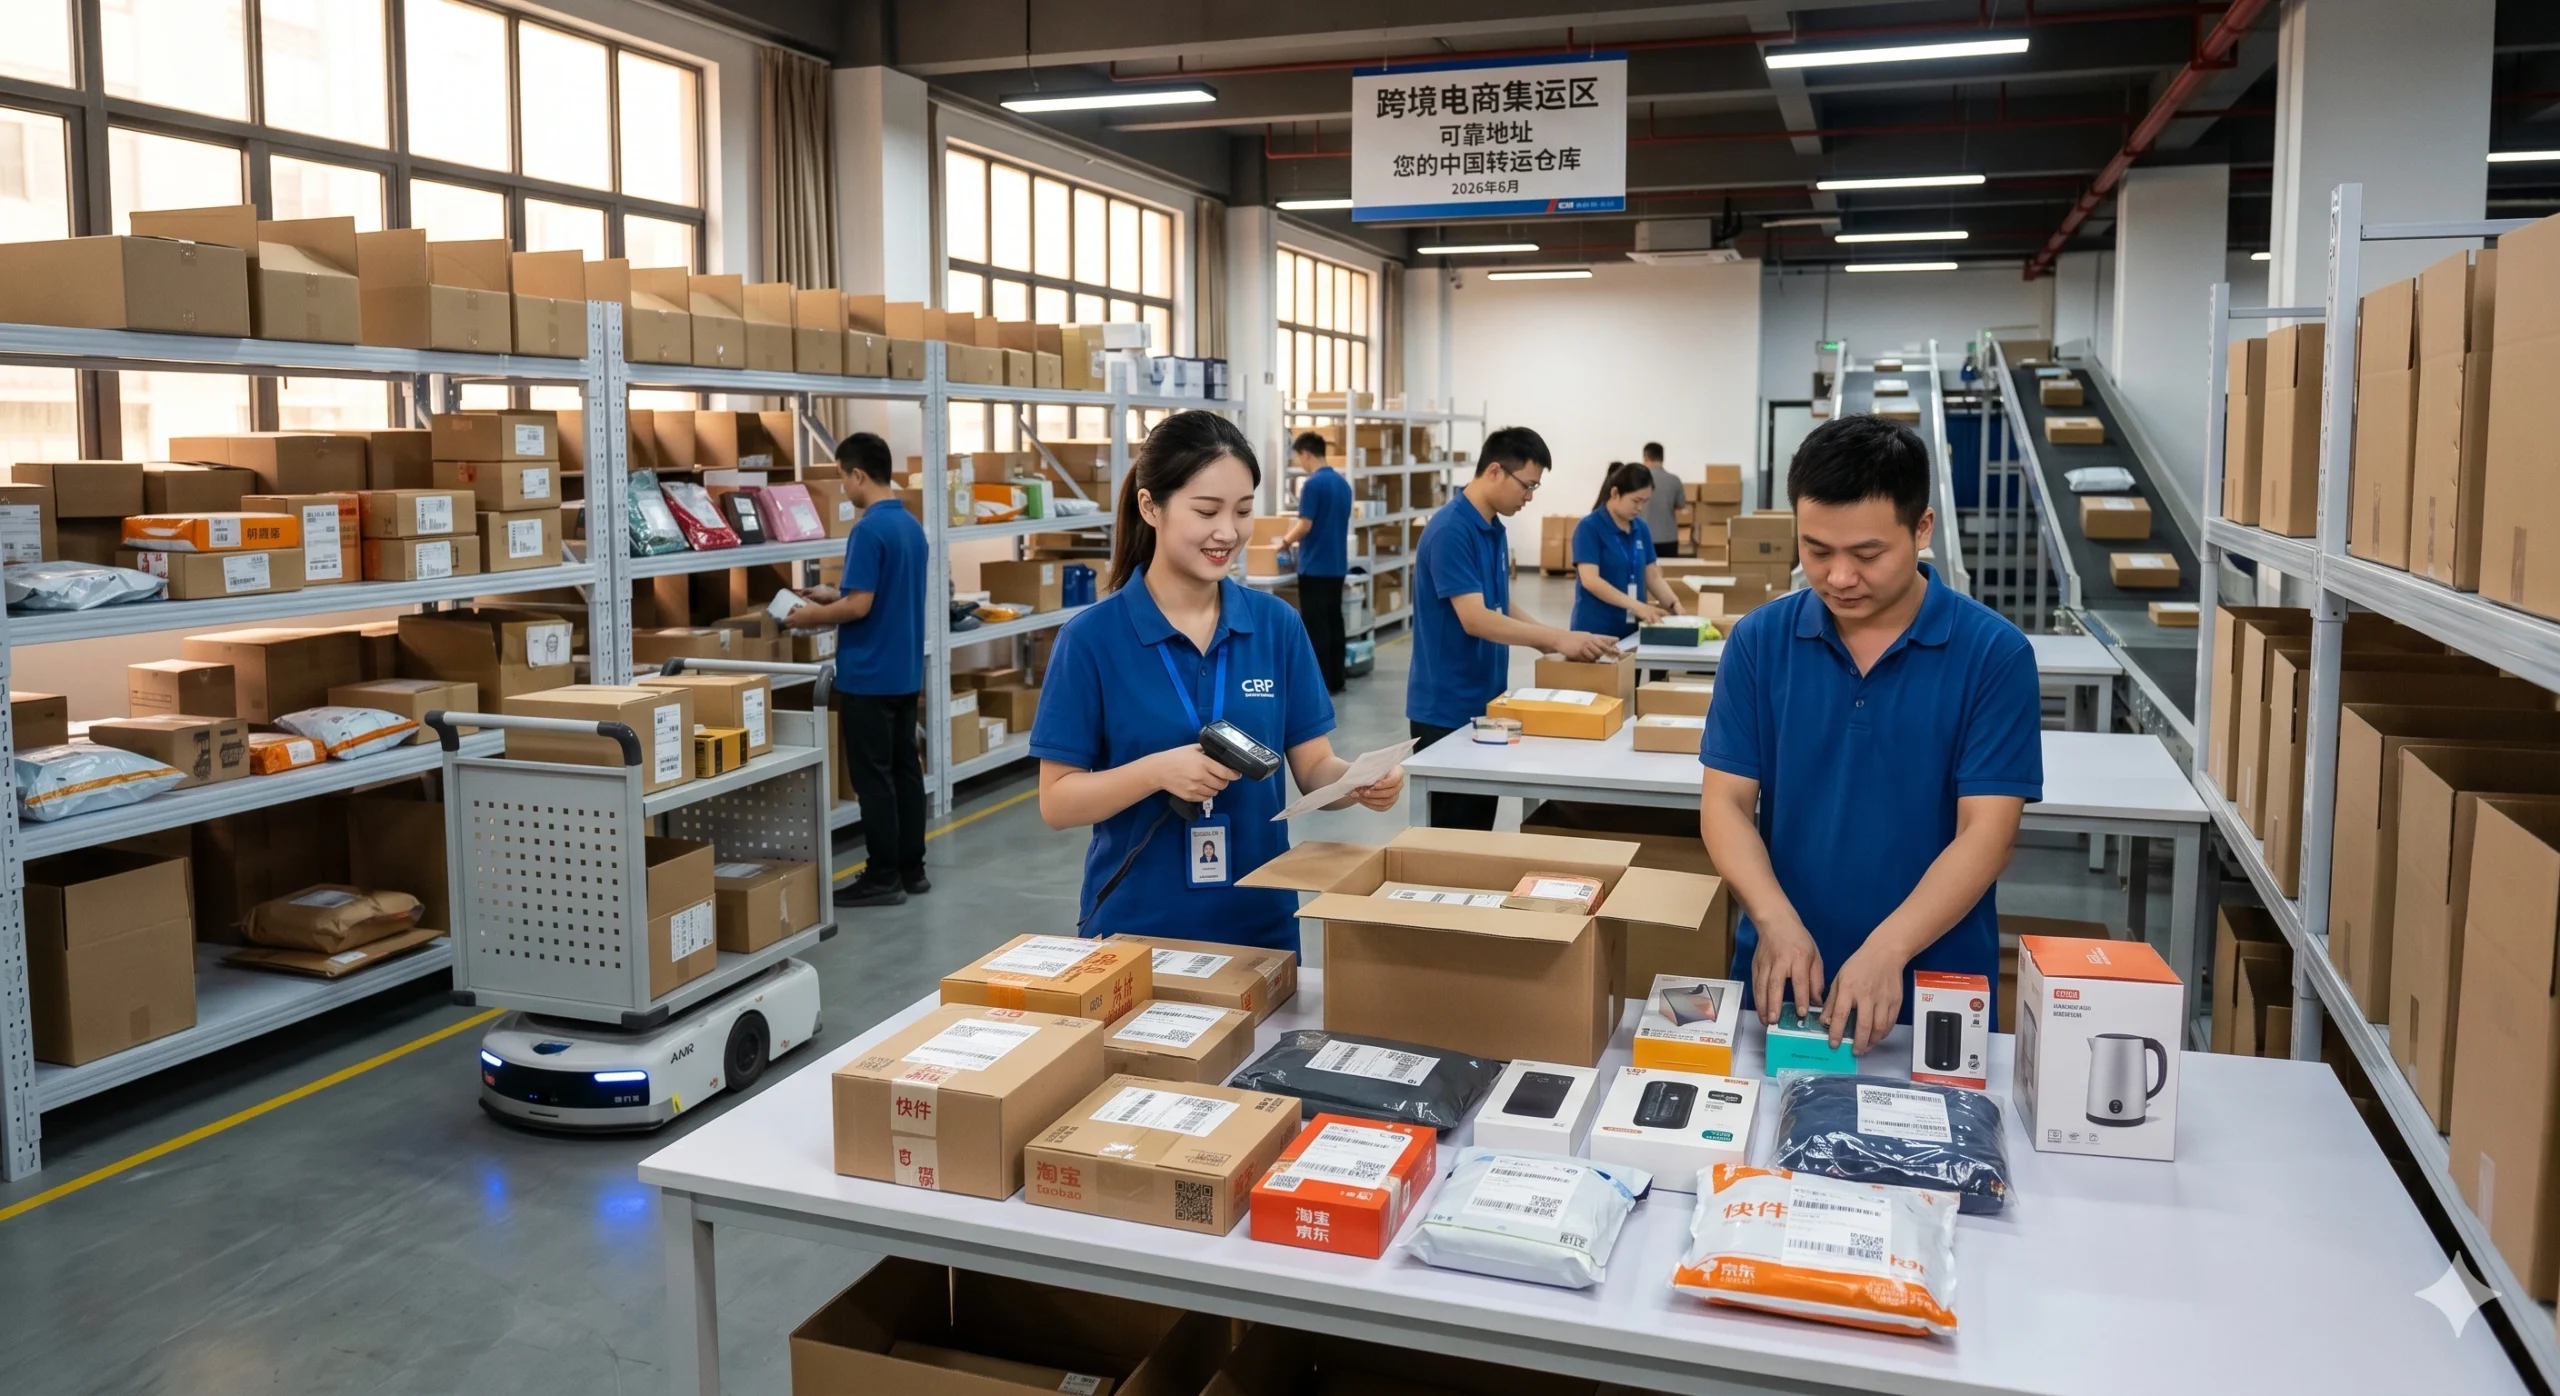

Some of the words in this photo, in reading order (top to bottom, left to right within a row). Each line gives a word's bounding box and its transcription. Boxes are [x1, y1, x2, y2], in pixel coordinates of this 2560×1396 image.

[1376, 77, 1599, 119] 跨境电商集运区
[1440, 120, 1534, 147] 可靠地址
[1393, 147, 1582, 177] 您的中国转运仓库
[1451, 179, 1520, 195] 2026年6月
[1241, 678, 1274, 693] CRP
[895, 1096, 932, 1120] 快件
[1036, 1160, 1081, 1188] 淘宝
[1295, 1206, 1330, 1227] 淘宝
[1723, 1200, 1788, 1219] 快件
[1296, 1225, 1330, 1243] 京东
